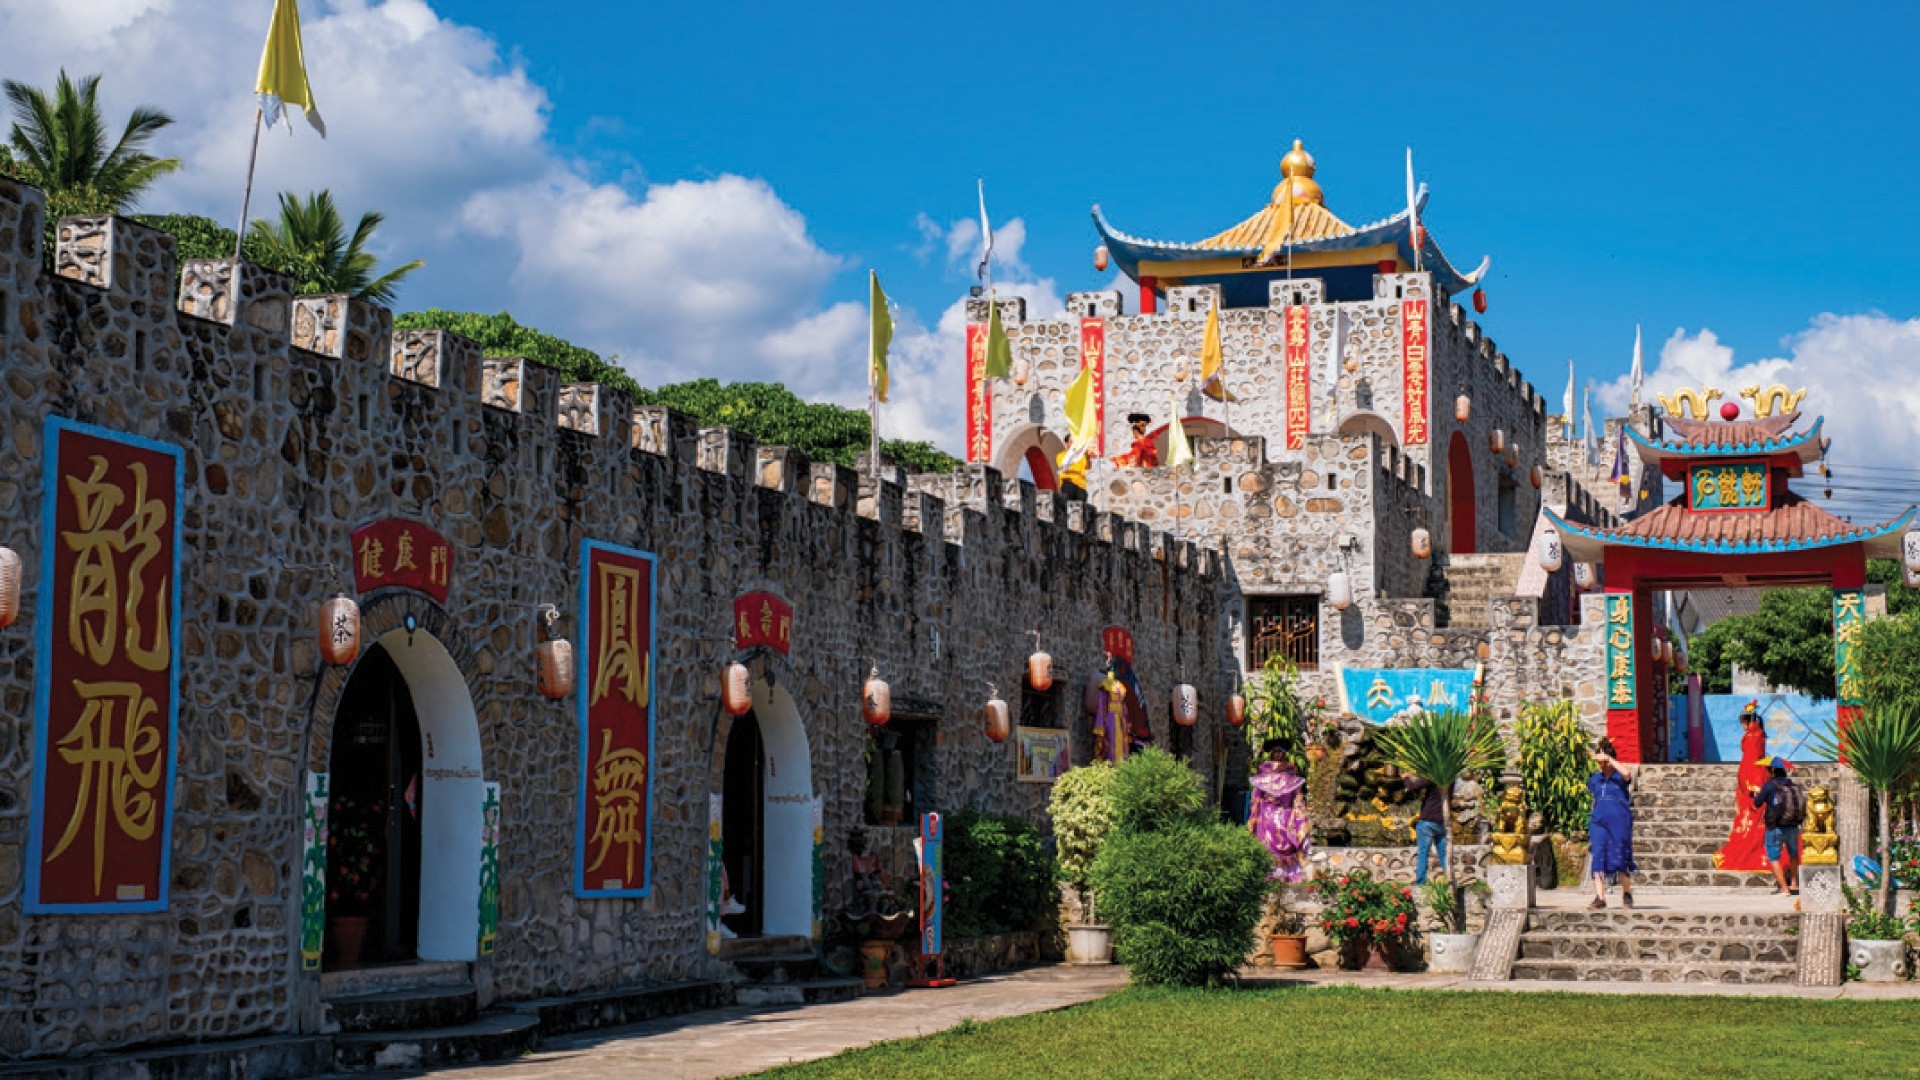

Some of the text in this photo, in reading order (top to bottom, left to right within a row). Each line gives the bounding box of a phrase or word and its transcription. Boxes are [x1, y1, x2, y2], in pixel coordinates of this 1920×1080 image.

[46, 455, 170, 897] 龍飛
[358, 529, 448, 586] 健康門
[586, 561, 650, 884] 鳳舞
